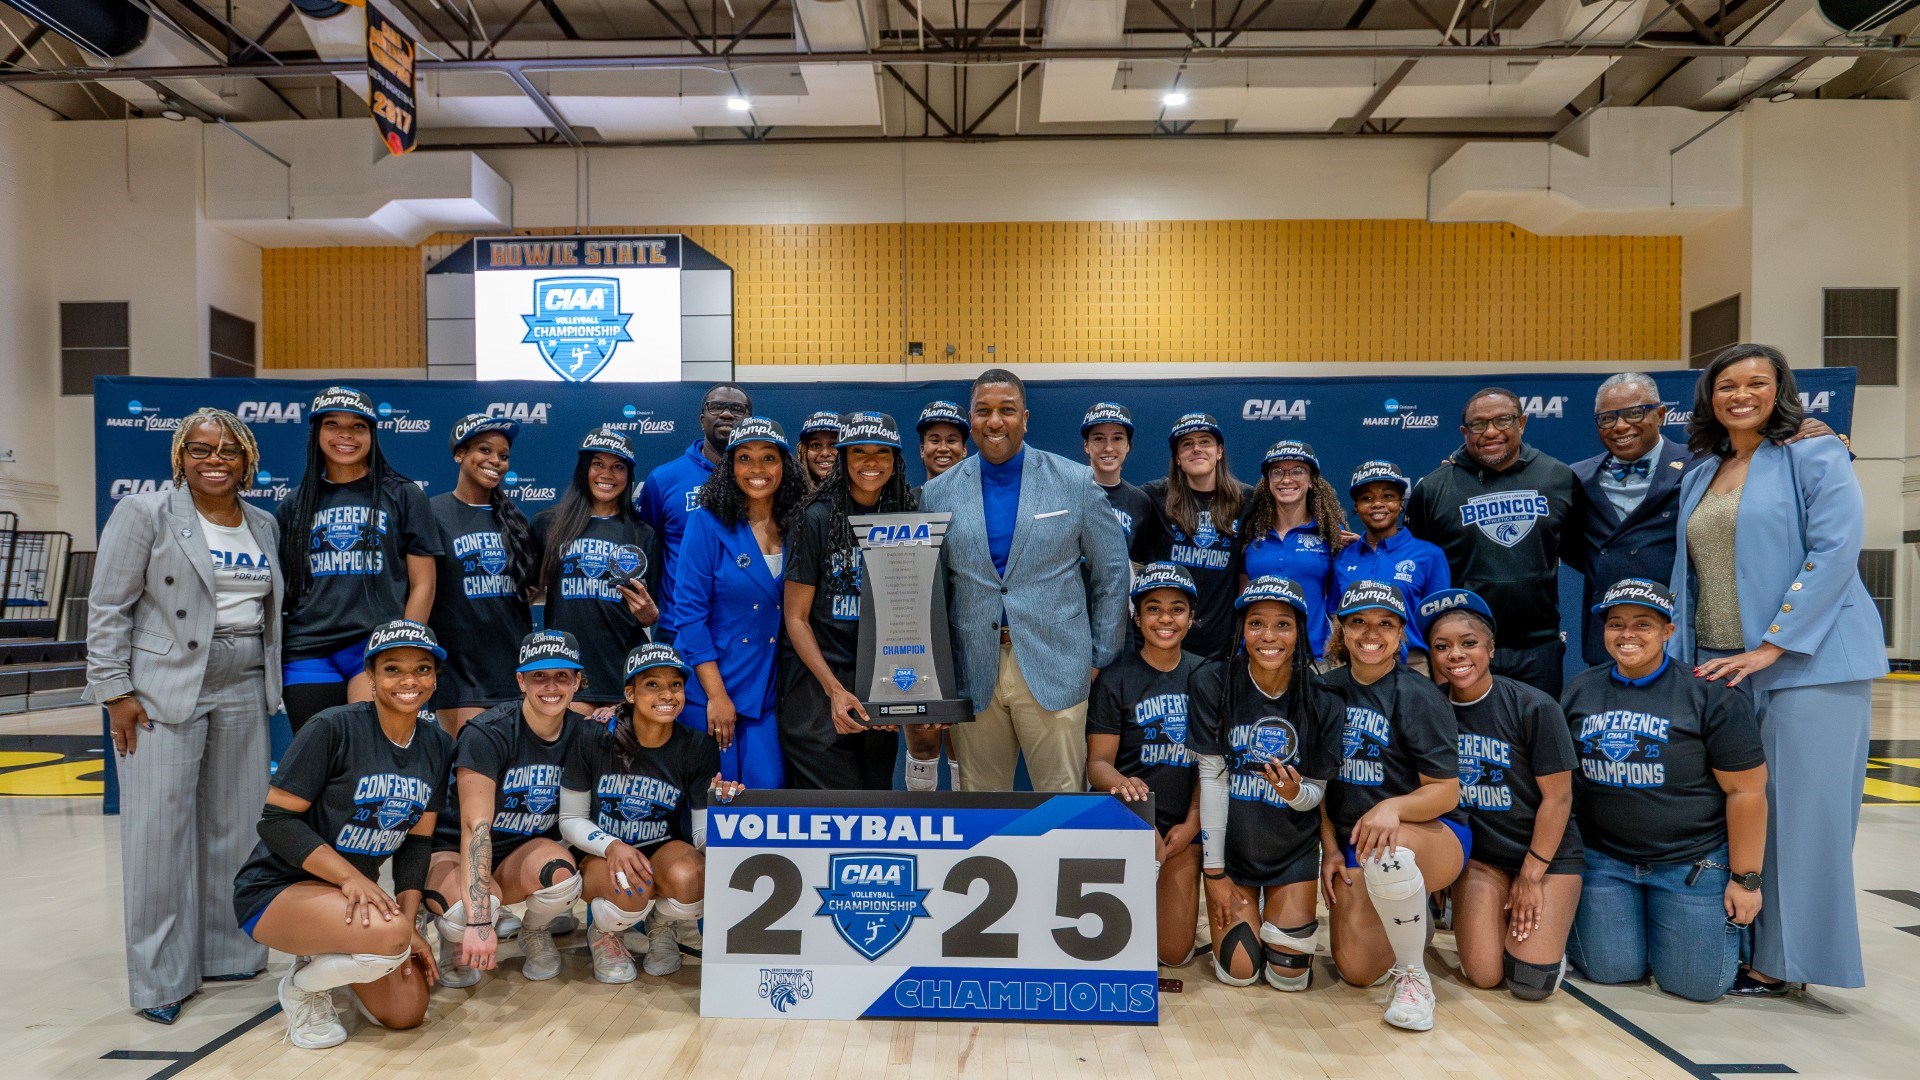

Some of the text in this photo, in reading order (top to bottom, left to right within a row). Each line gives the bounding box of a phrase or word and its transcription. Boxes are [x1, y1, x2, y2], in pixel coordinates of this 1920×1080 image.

[373, 91, 412, 135] 2017
[490, 239, 667, 266] BOWIE STATE
[545, 288, 605, 311] CIAA
[555, 316, 600, 325] VOLLEYBALL
[533, 326, 621, 338] CHAMPIONSHIP
[237, 401, 301, 424] CIAA
[485, 402, 548, 424] CIAA
[1242, 399, 1307, 421] CIAA
[1519, 396, 1563, 419] IAA
[106, 414, 182, 432] MAKE IT YOURS
[384, 421, 393, 429] IT
[393, 415, 431, 433] YOURS
[602, 417, 675, 435] MAKE IT YOURS
[1174, 425, 1210, 437] CIAA
[1362, 412, 1439, 430] MAKE IT YOURS
[839, 422, 900, 443] Champions
[263, 489, 273, 498] IT
[511, 489, 519, 498] IT
[519, 484, 556, 501] YOURS
[1460, 496, 1549, 526] BRONCOS
[1484, 516, 1513, 524] ATHLETICS
[867, 524, 932, 547] CIAA
[464, 560, 475, 572] 20
[1171, 545, 1231, 568] CHAMPIONS
[233, 572, 252, 580] FOR
[563, 562, 574, 574] 20
[463, 575, 517, 596] CHAMPION
[1134, 570, 1195, 590] Champions
[1342, 589, 1405, 611] Champions
[1420, 593, 1469, 617] CIAA
[1603, 587, 1671, 610] Champions
[519, 643, 580, 665] Champions
[882, 644, 926, 656] CHAMPION
[918, 705, 926, 713] 25
[1144, 727, 1157, 740] 20
[1581, 710, 1670, 741] CONFERENCE
[1367, 743, 1380, 757] 25
[1457, 734, 1510, 765] ERENCE
[1644, 744, 1660, 758] 25
[1339, 758, 1384, 782] MPIONS
[1489, 769, 1504, 782] 25
[1581, 757, 1665, 785] CHAMPIONS
[353, 774, 432, 808] CONFERENCE
[597, 774, 681, 808] CONFERENCE
[1460, 785, 1511, 807] MPIONS
[387, 800, 407, 808] CIAA
[504, 796, 519, 809] 20
[601, 800, 612, 813] 20
[625, 798, 646, 806] CIAA
[352, 807, 371, 822] 20
[597, 811, 669, 841] CHAMPIONS
[714, 814, 964, 843] VOLLEYBALL
[841, 864, 901, 885] CIAA
[726, 853, 803, 956] 2
[829, 900, 917, 911] CHAMPIONSHIP
[851, 891, 894, 899] VOLLEYBALL
[758, 968, 813, 1000] BRONCOS
[894, 979, 1155, 1014] CHAMPIONS
